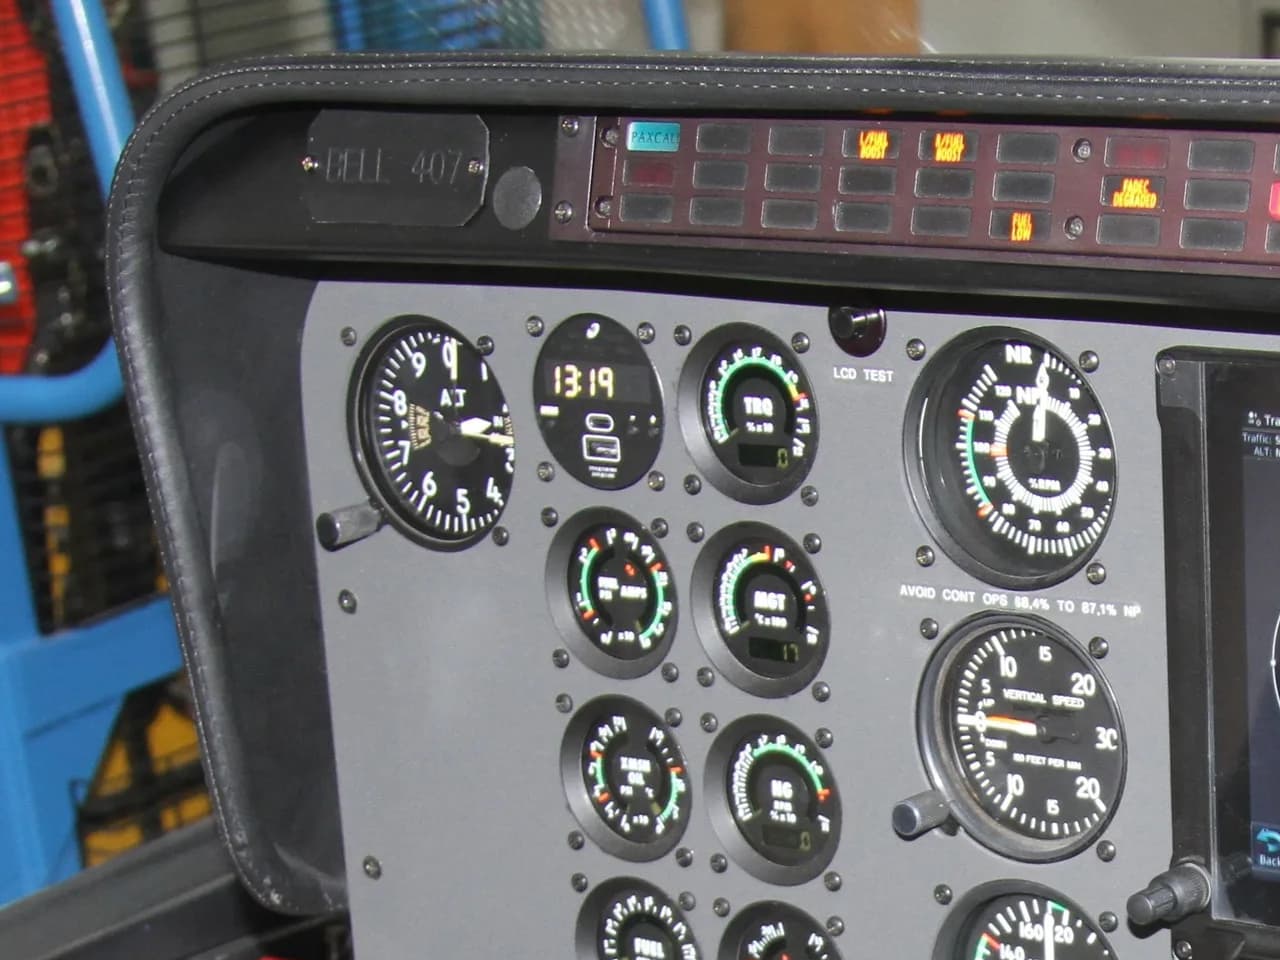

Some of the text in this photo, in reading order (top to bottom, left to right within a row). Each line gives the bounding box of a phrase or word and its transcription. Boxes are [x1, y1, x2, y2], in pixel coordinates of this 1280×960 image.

[412, 151, 462, 185] 407
[1012, 213, 1033, 227] FUEL
[1011, 225, 1032, 241] LOW
[1006, 345, 1032, 364] NR
[554, 364, 614, 398] 13:19
[833, 367, 894, 382] LCD TEST
[900, 584, 936, 598] AVOID
[942, 588, 976, 602] CONT
[983, 592, 1008, 606] OPS
[1058, 600, 1074, 612] TO
[1000, 656, 1017, 678] 10
[1071, 673, 1095, 696] 20
[1003, 688, 1084, 709] VERTICAL SPEED
[1076, 776, 1100, 799] 20
[1055, 925, 1074, 944] 20
